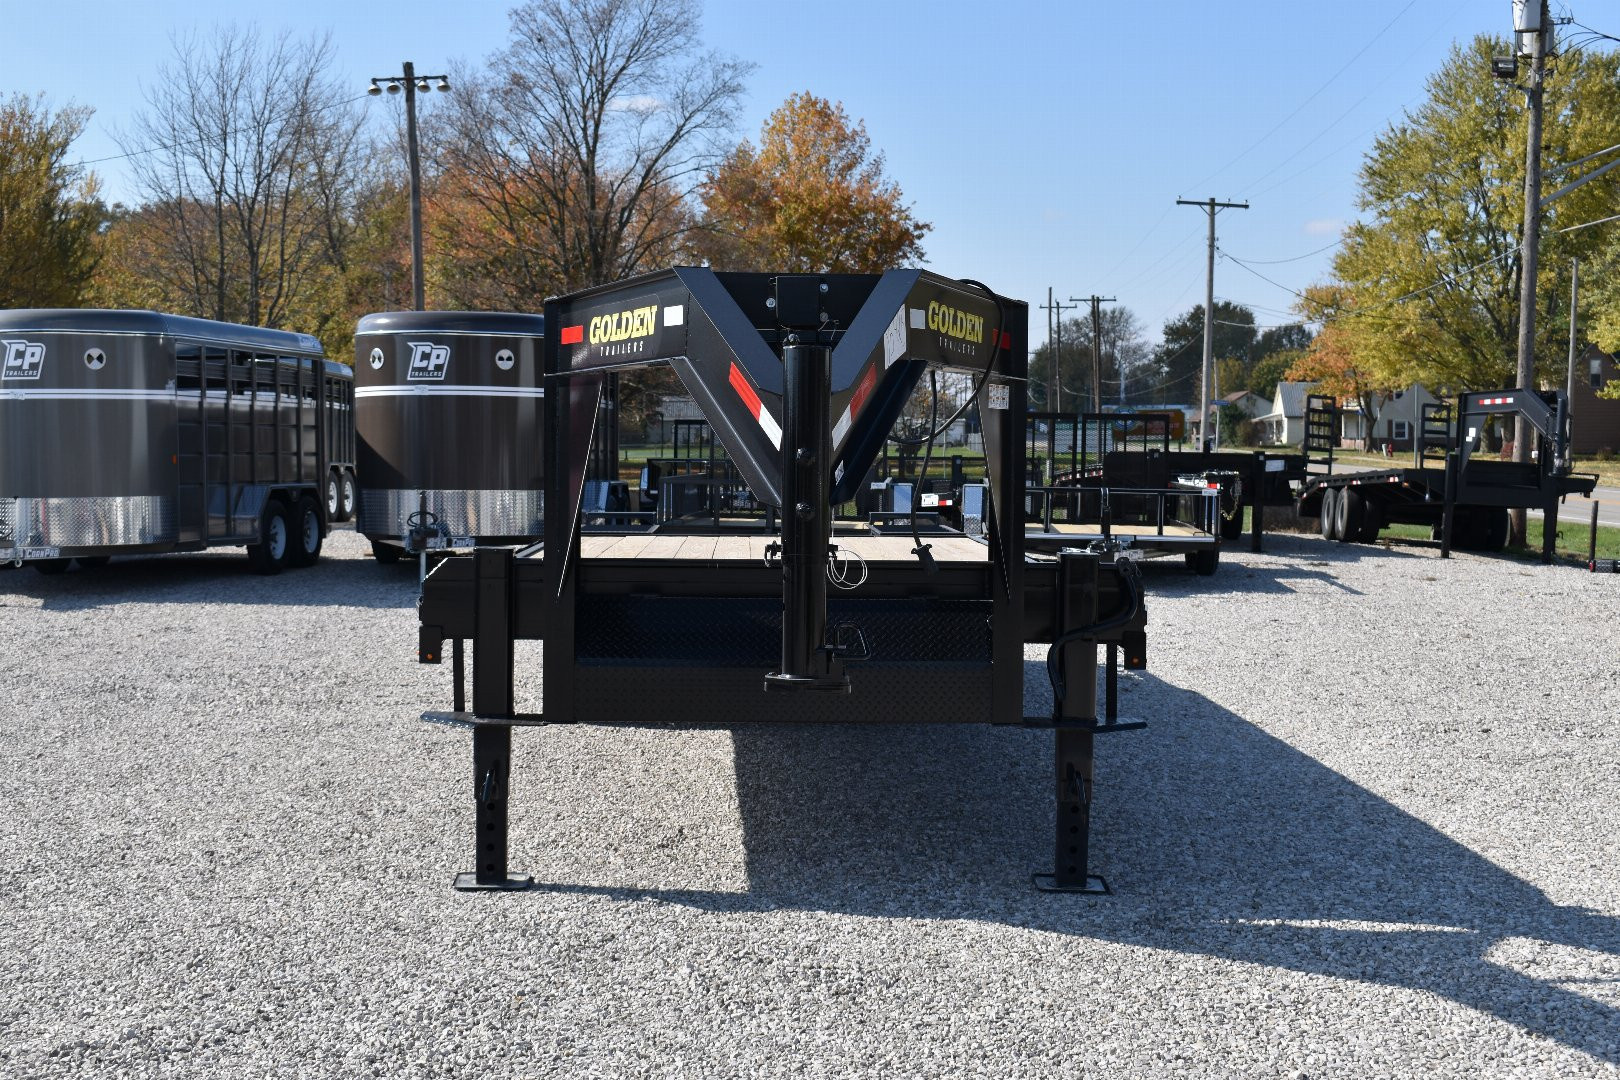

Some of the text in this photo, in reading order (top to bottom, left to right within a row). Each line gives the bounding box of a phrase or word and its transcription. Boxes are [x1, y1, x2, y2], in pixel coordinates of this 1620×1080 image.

[589, 305, 658, 345] GOLDEN
[928, 300, 984, 344] GOLDEN
[7, 343, 43, 370] CP
[413, 345, 447, 371] CP
[600, 340, 644, 357] TRAILERS
